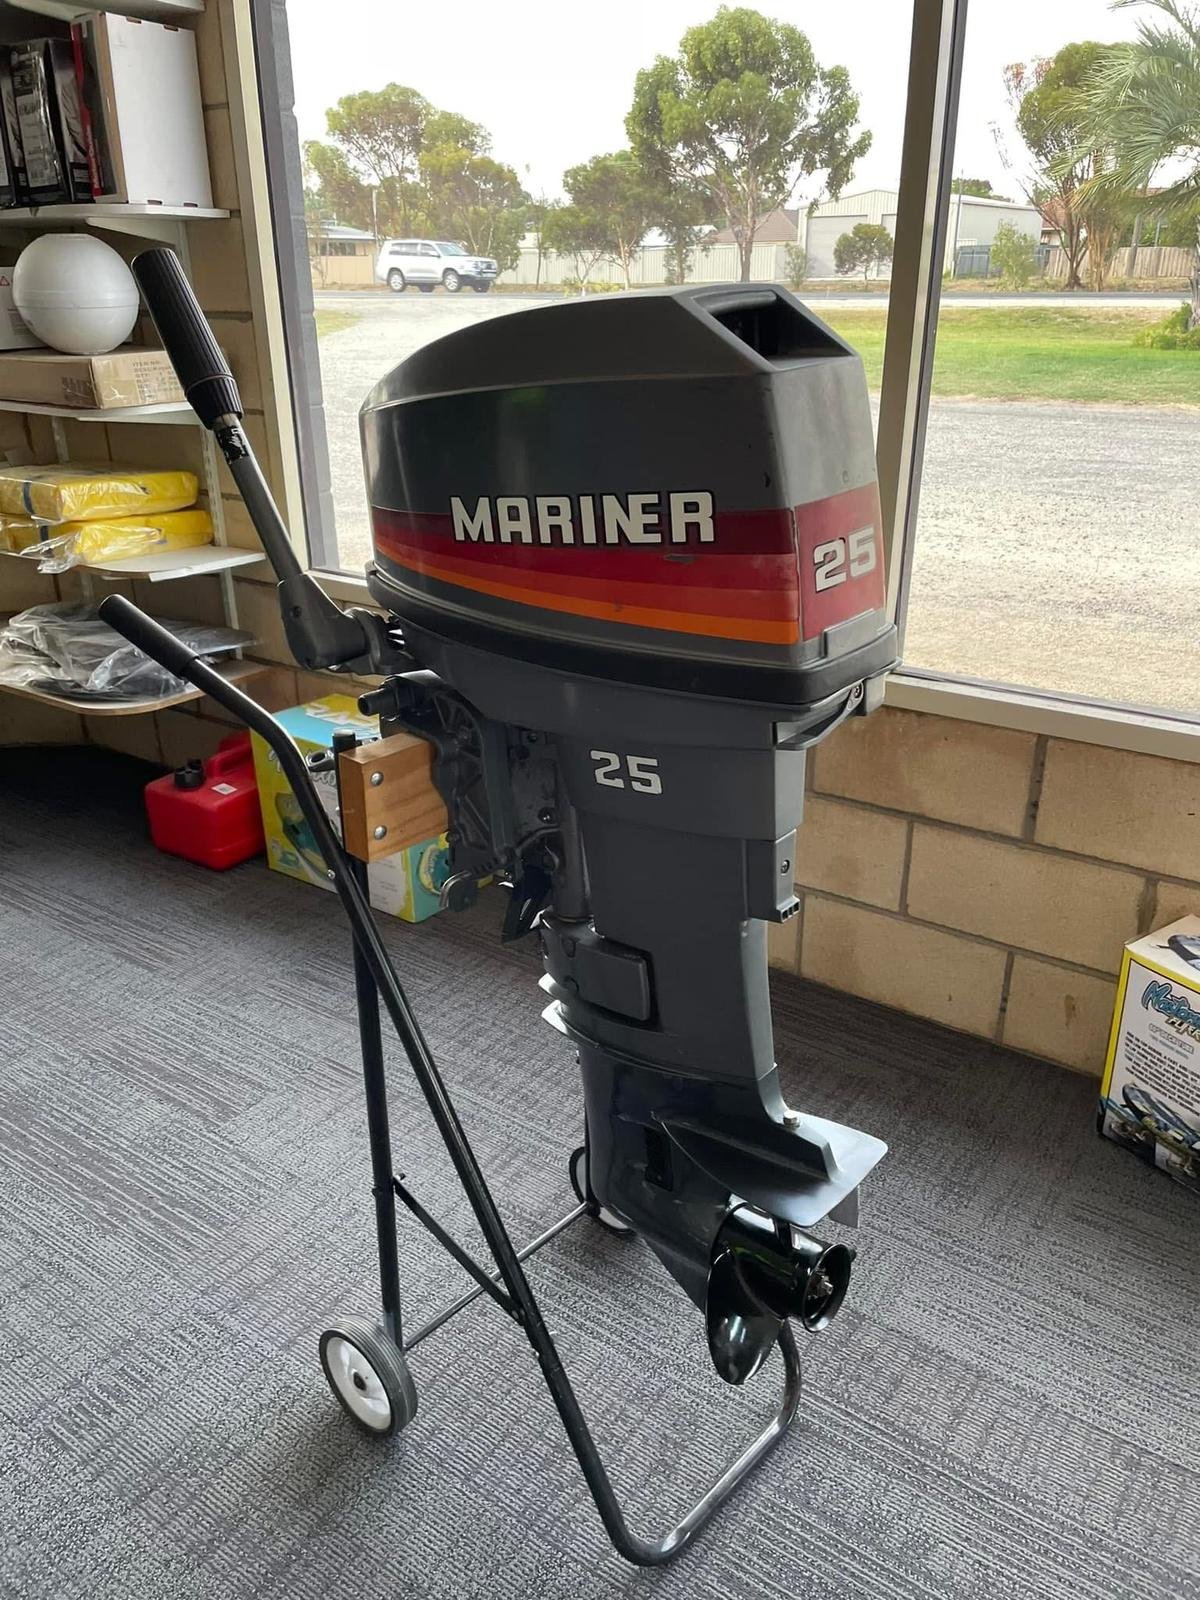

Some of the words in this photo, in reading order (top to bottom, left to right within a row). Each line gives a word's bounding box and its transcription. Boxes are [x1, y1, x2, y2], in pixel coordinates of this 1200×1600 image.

[450, 491, 715, 544] MARINER
[813, 526, 876, 593] 25
[590, 749, 663, 795] 25
